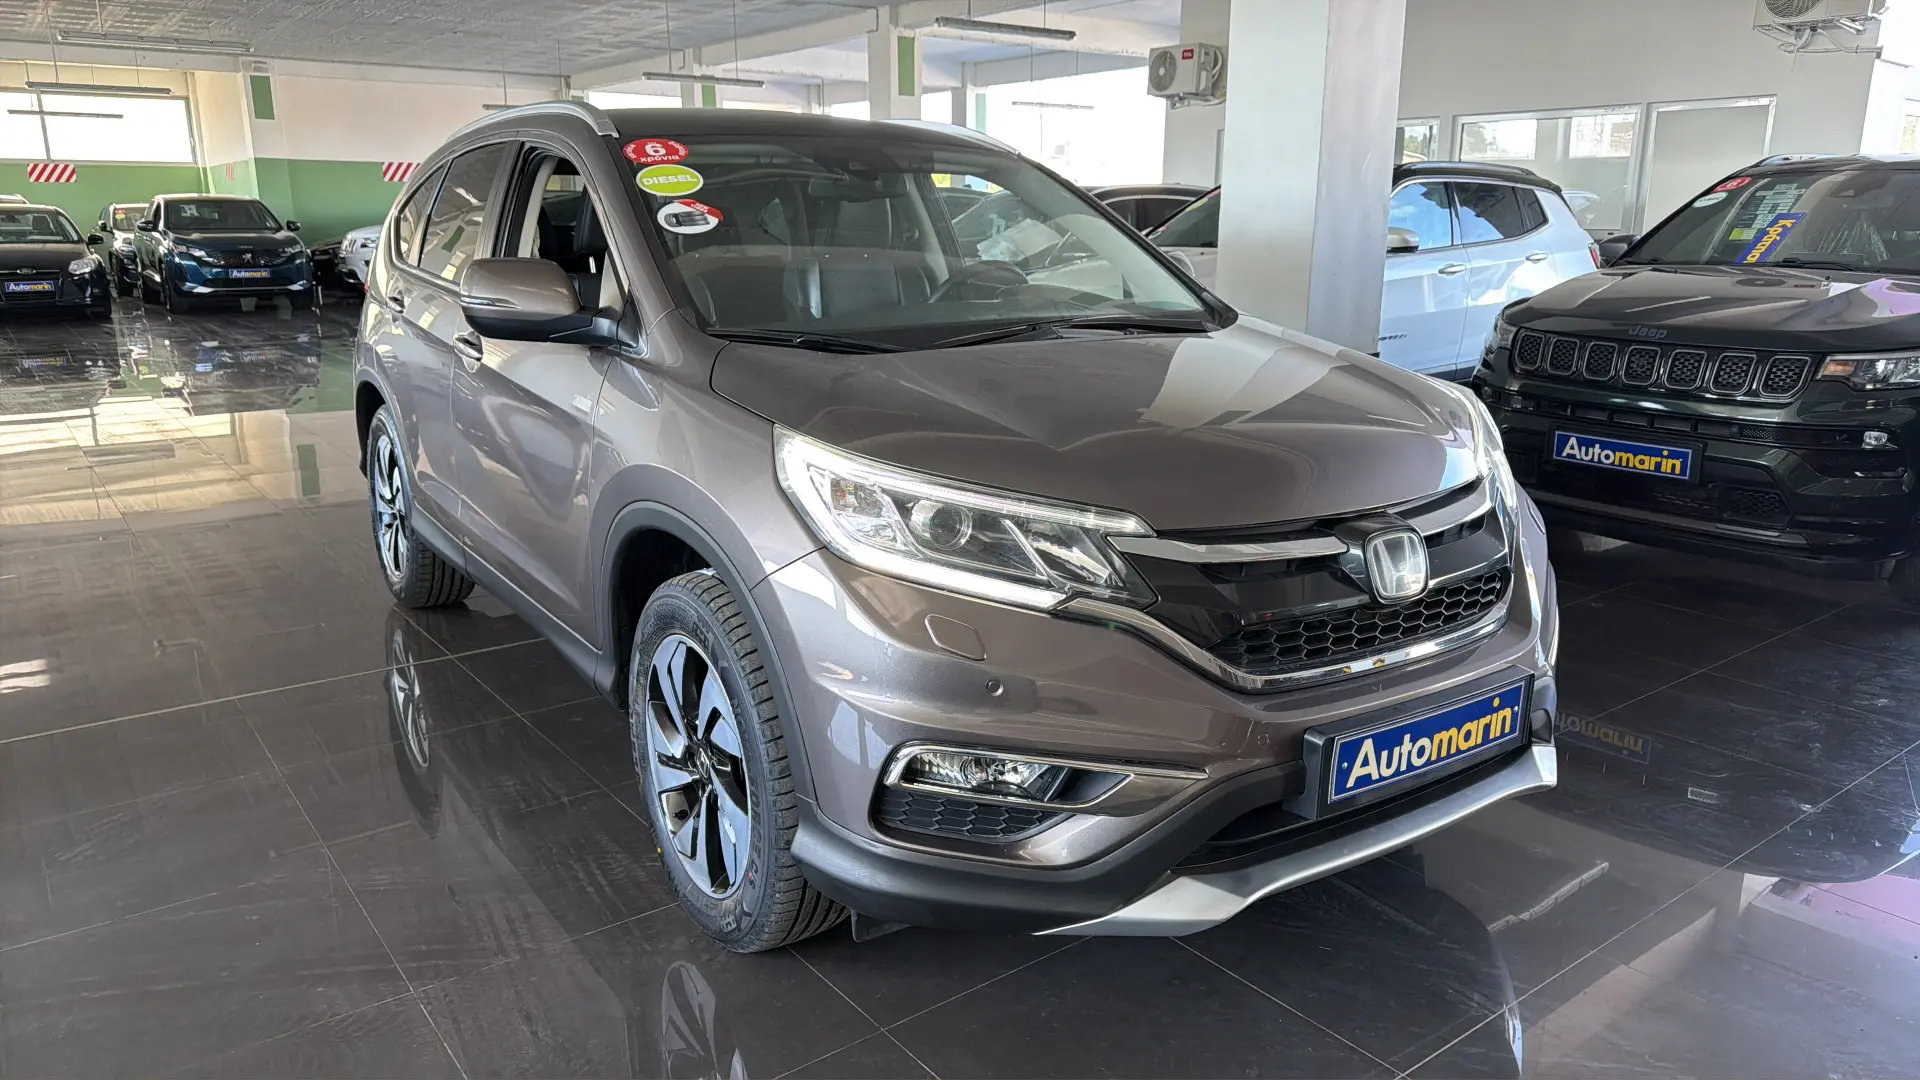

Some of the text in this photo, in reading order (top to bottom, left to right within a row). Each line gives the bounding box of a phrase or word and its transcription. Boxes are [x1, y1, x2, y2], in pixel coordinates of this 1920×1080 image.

[645, 143, 667, 156] 6
[640, 154, 680, 163] χρόνια
[642, 174, 698, 186] DIESEL
[232, 268, 268, 279] Automarin
[9, 281, 51, 292] Automarin
[1628, 324, 1668, 340] Jeep
[1561, 436, 1682, 475] Automarin
[1346, 696, 1513, 789] Automarin
